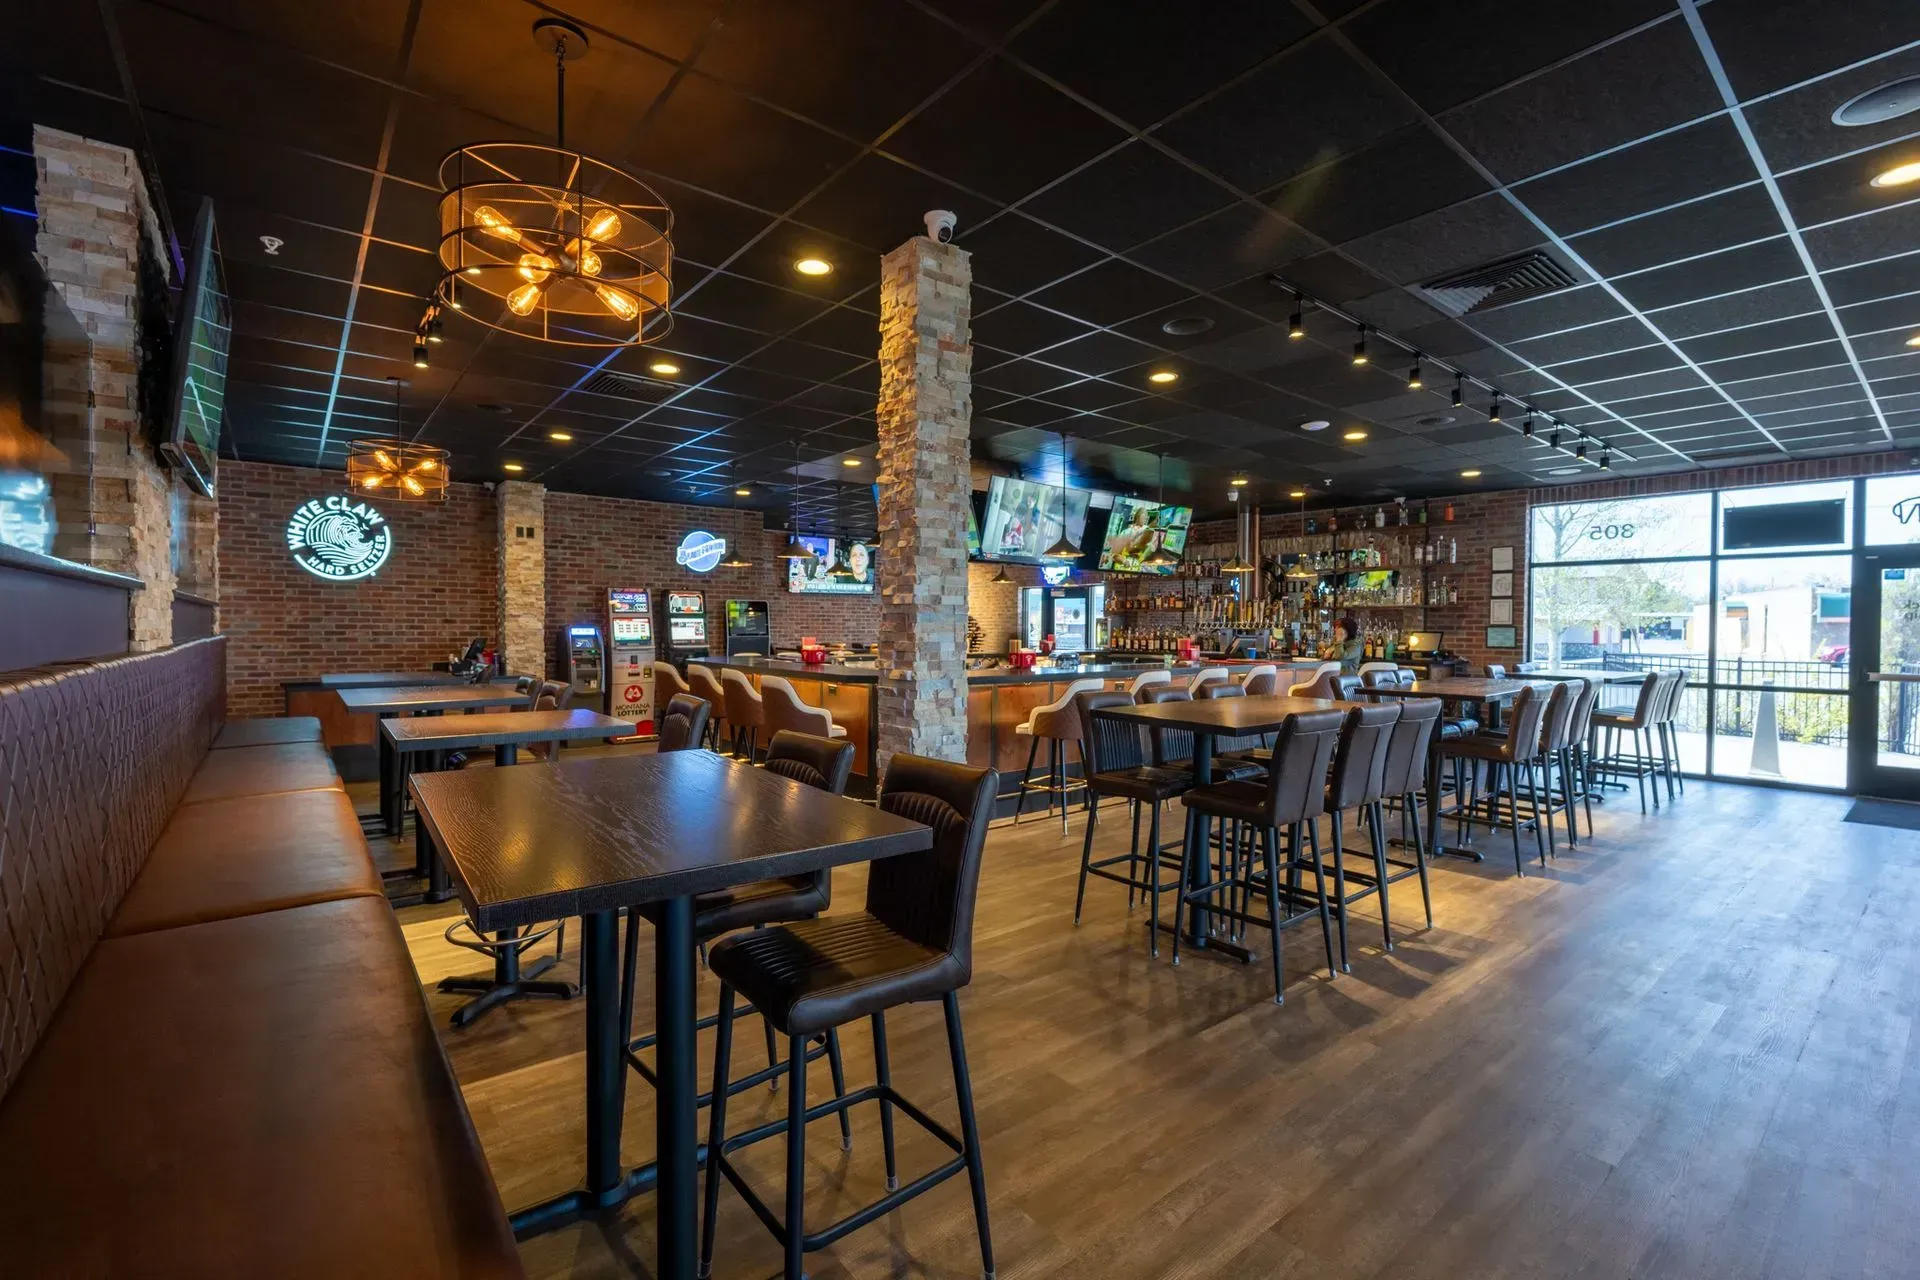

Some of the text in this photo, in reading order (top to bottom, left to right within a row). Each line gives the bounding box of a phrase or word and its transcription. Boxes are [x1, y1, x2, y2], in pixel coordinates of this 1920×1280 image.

[287, 496, 385, 550] WHITE CLAW
[307, 535, 385, 575] HARD SELTZER
[615, 703, 650, 711] MONTANA
[618, 709, 648, 717] LOTTERY
